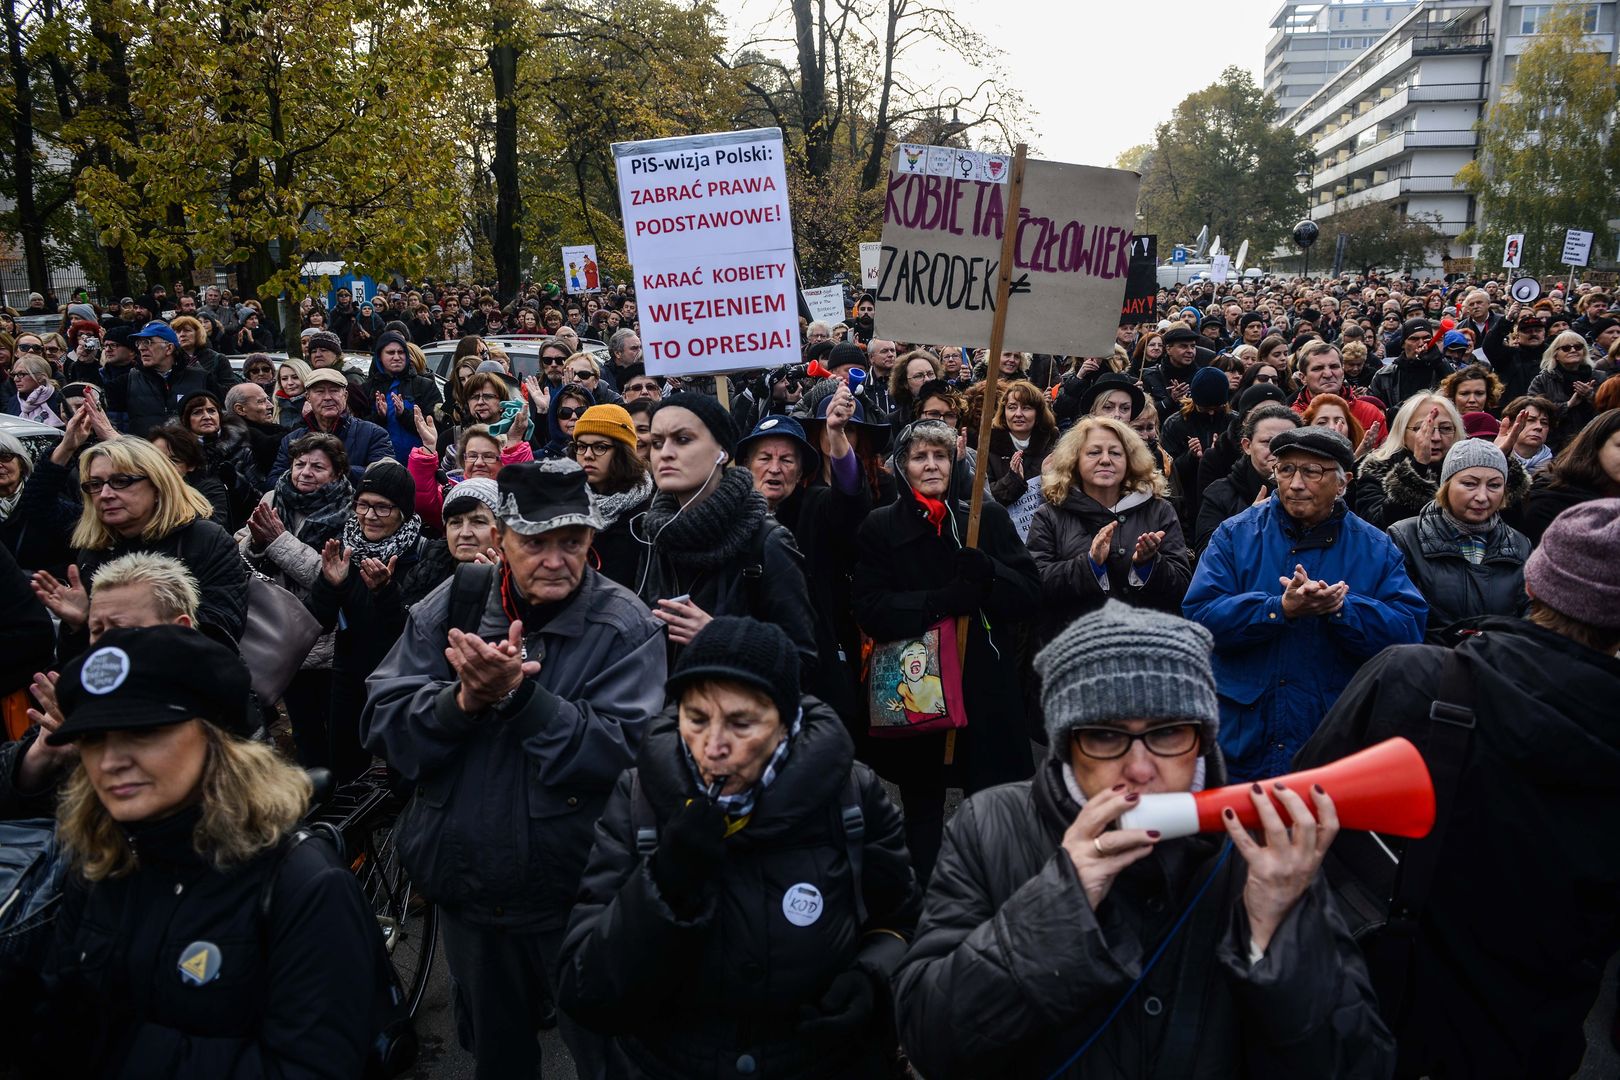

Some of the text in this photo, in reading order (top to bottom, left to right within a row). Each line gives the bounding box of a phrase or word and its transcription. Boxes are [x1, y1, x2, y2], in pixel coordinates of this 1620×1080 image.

[631, 145, 774, 175] PiS-wizja Polski:
[631, 176, 776, 206] ZABRAĆ PRAWA
[635, 204, 782, 236] PODSTAWOWE!
[883, 172, 1005, 240] KOBIETA
[1013, 216, 1134, 280] CZŁOWIEK
[1130, 237, 1150, 257] Y!
[1175, 250, 1184, 260] P
[642, 263, 787, 290] KARAĆ KOBIETY
[876, 246, 1000, 312] ZARODEK
[648, 293, 786, 325] WIĘZIENIEM
[649, 328, 792, 360] TO OPRESJA!
[790, 897, 818, 914] KOD
